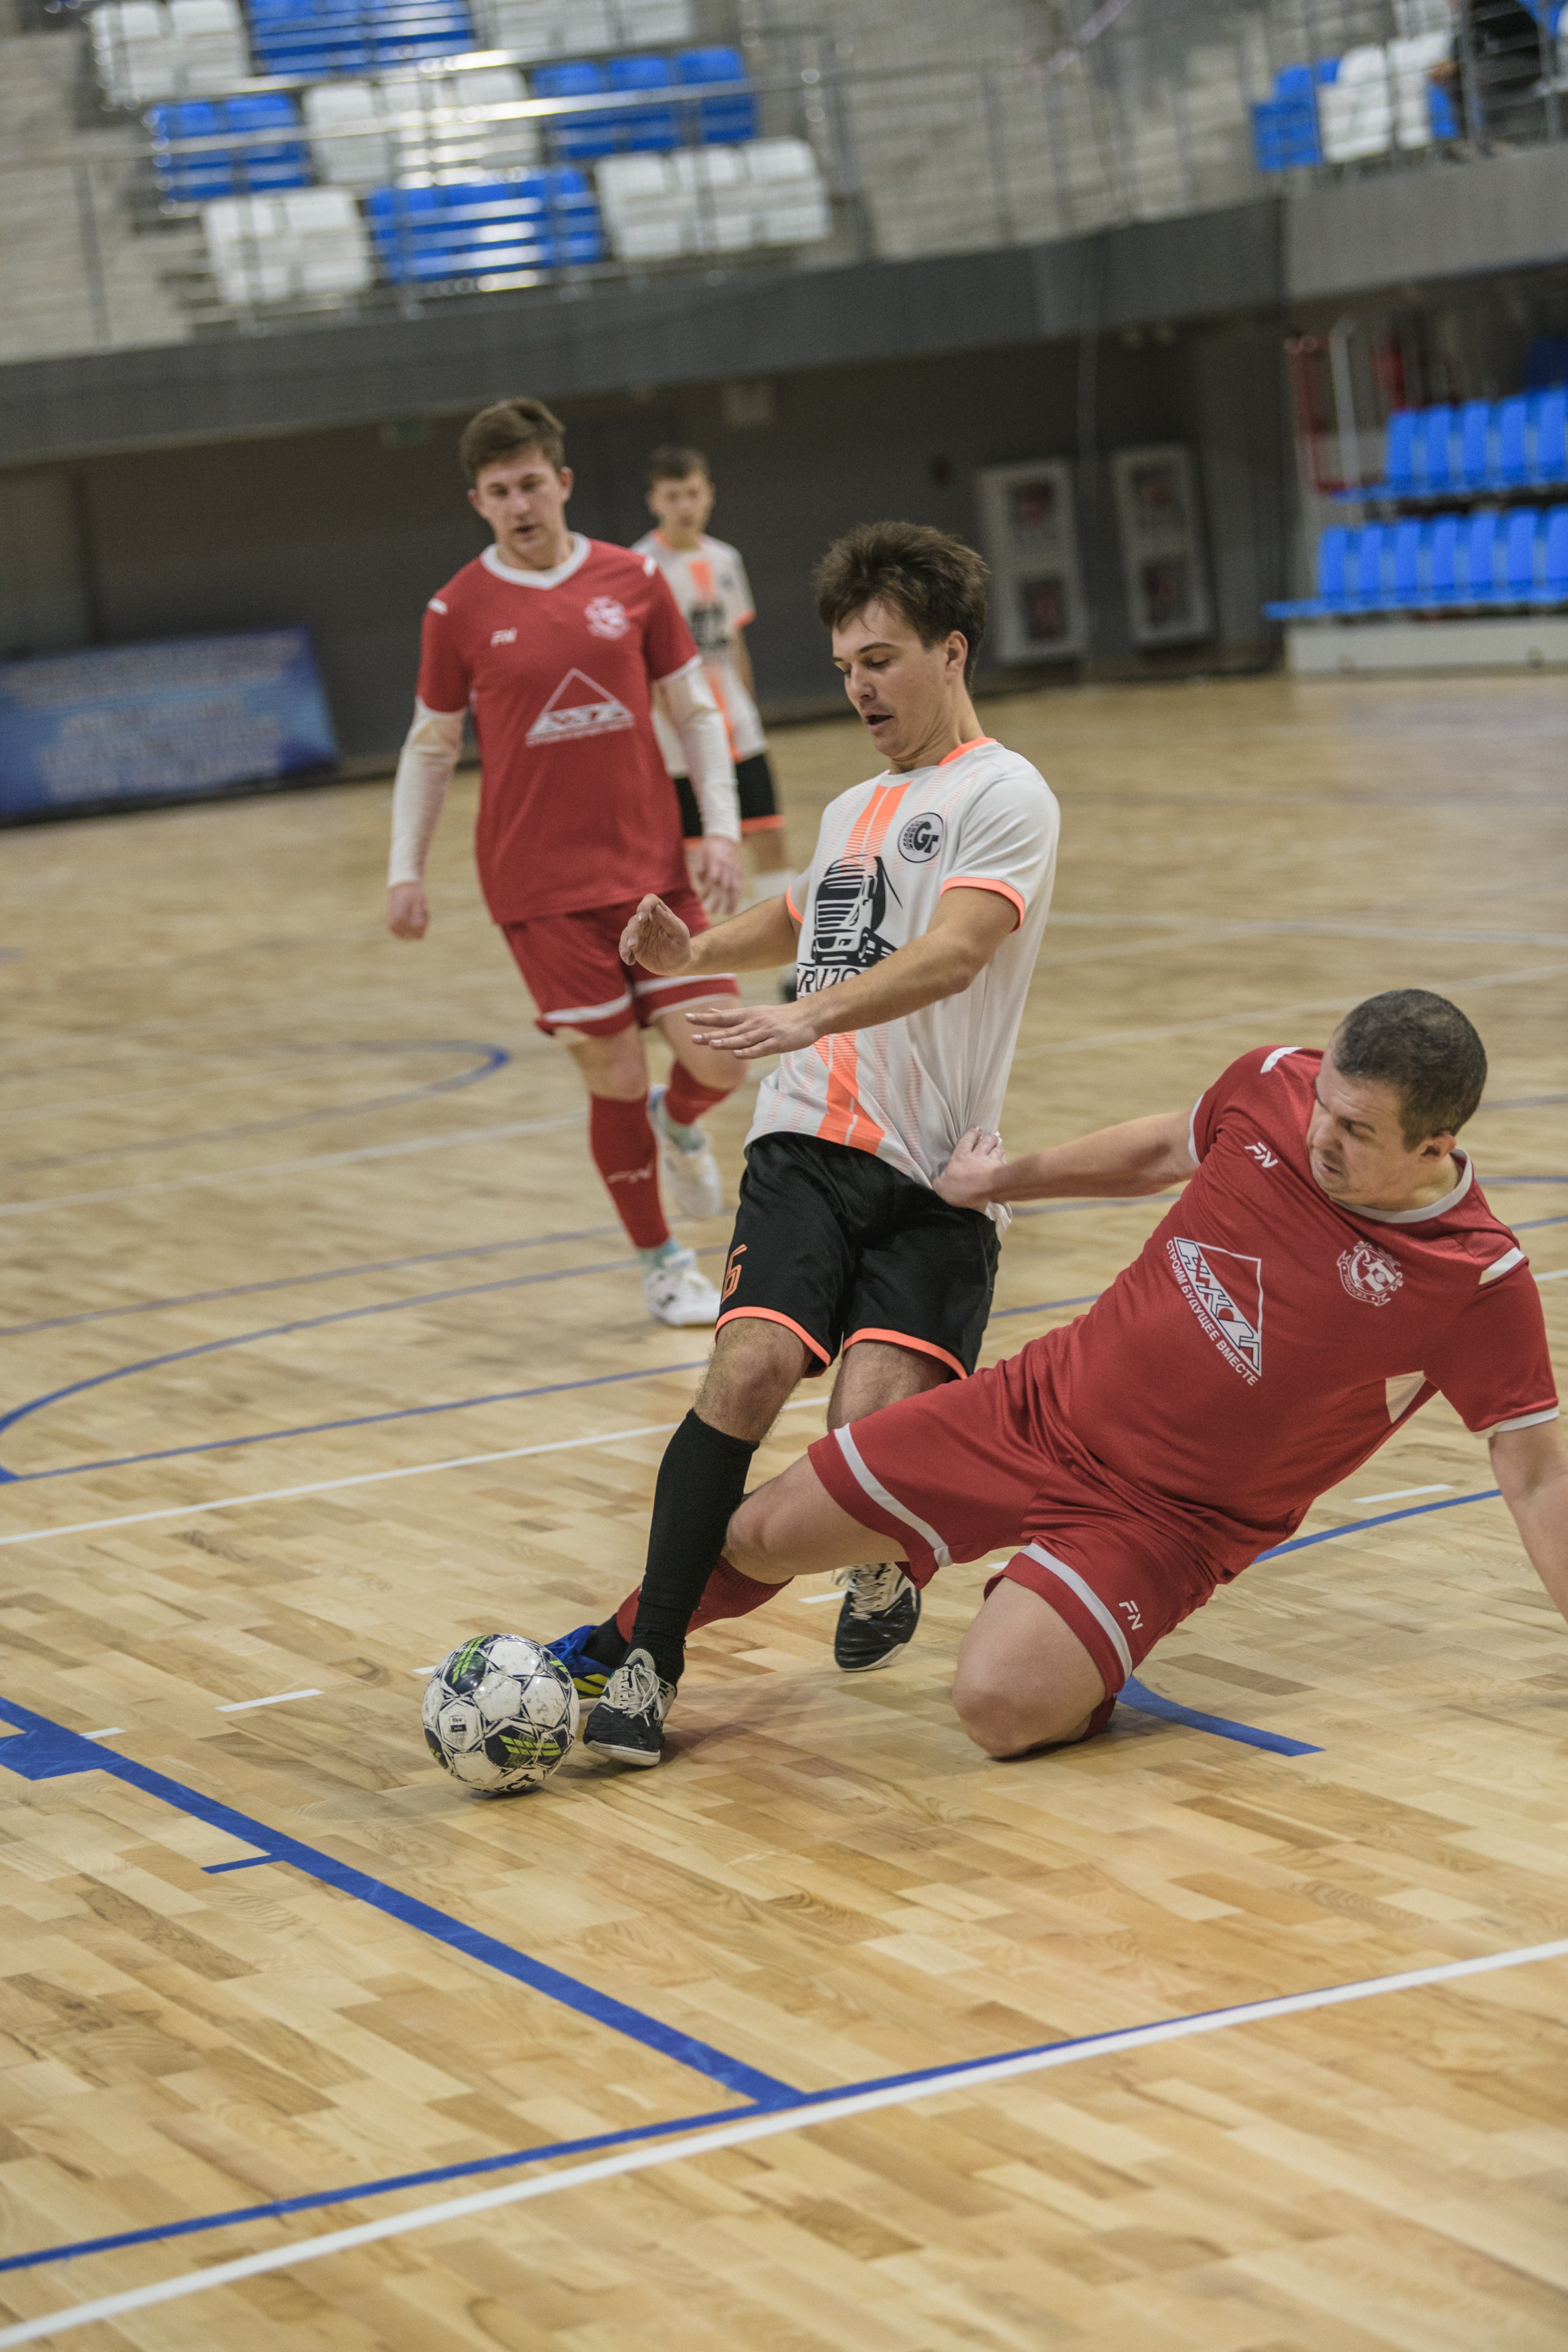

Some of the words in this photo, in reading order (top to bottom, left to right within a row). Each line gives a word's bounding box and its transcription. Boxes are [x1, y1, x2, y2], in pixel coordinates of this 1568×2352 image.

[1245, 1142, 1278, 1168] FN
[721, 1244, 748, 1304] 6
[1166, 1240, 1188, 1285] СТРОИМ
[1181, 1283, 1220, 1341] БУДУЩЕЕ
[1215, 1340, 1259, 1386] ВМЕСТЕ
[1118, 1600, 1144, 1630] FN
